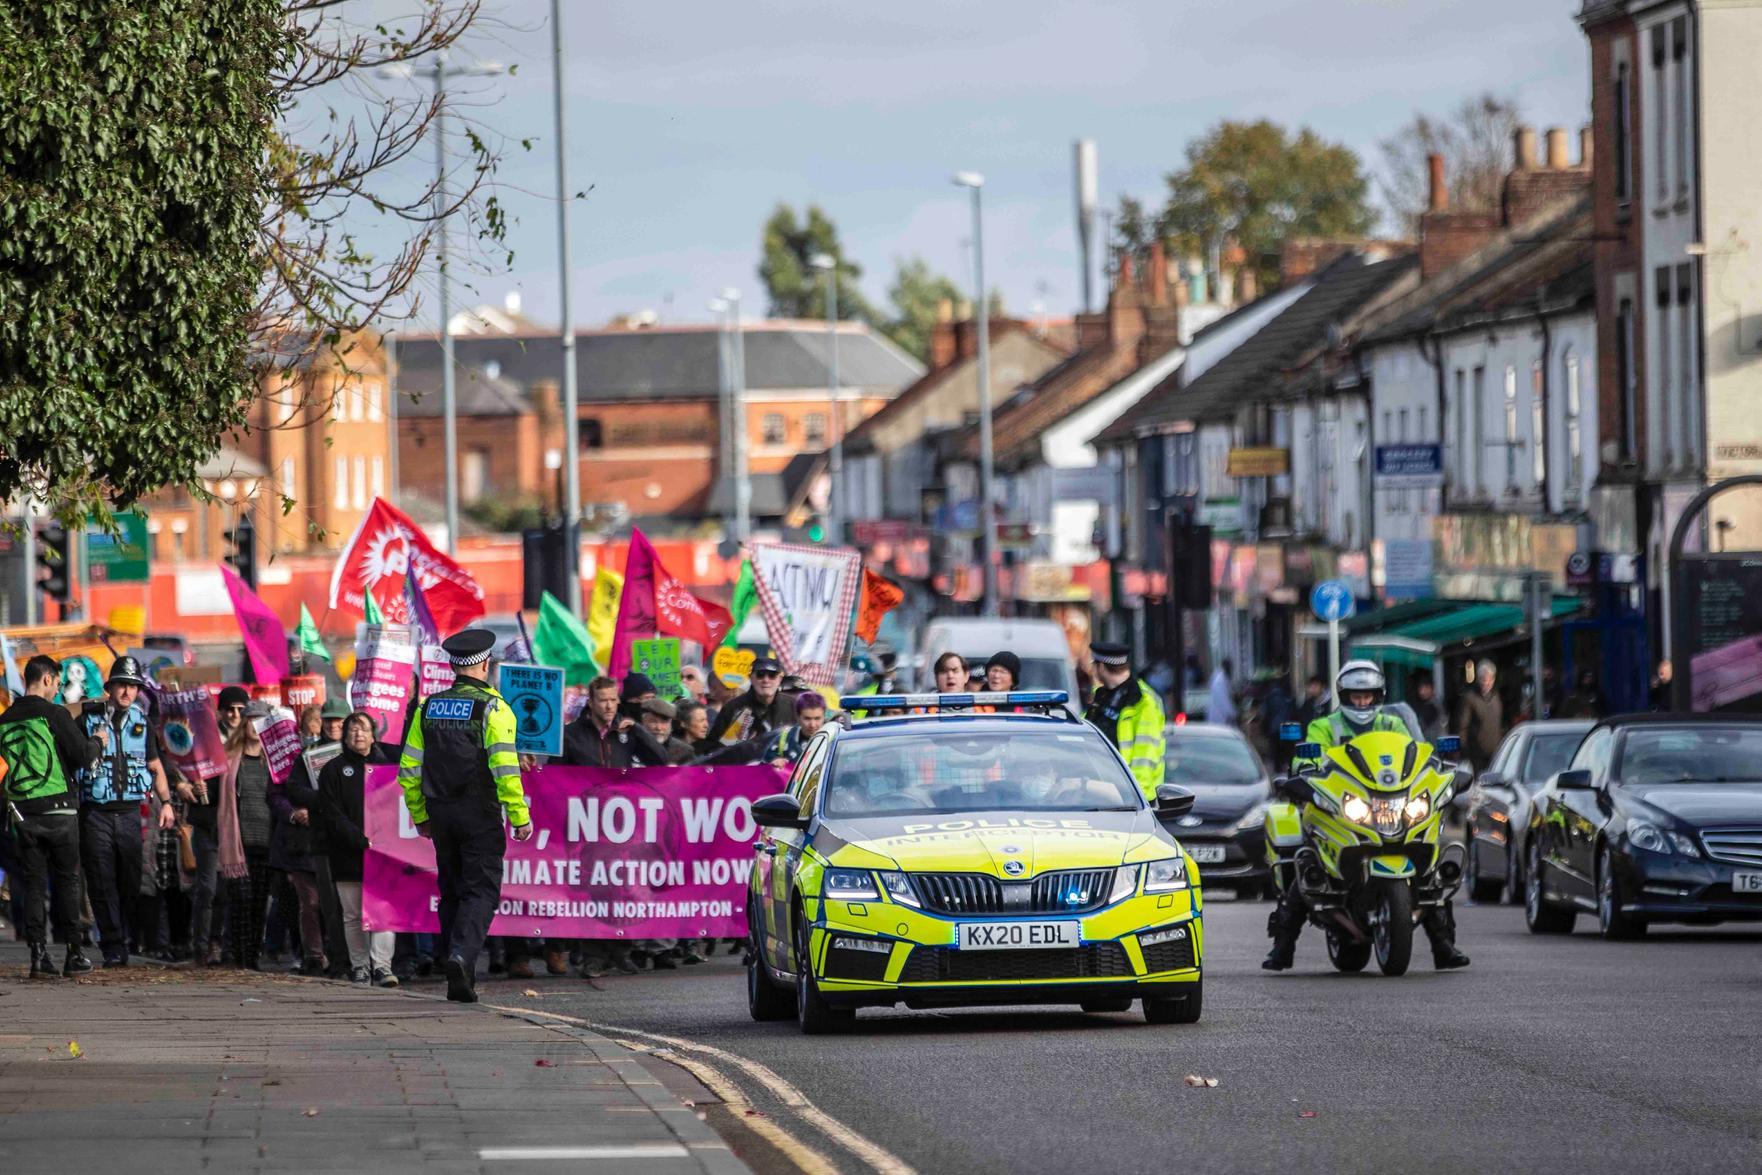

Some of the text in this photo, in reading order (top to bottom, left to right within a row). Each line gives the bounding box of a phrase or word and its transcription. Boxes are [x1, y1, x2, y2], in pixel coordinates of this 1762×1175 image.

[638, 643, 674, 657] LET
[423, 664, 457, 682] Clima
[506, 669, 558, 682] THERE IS NO
[511, 679, 553, 692] PLANET B
[287, 688, 316, 706] STOP
[428, 702, 470, 717] POLICE
[567, 796, 664, 844] NOT
[903, 818, 1093, 834] POLICE
[887, 829, 1120, 846] INTERCEPTOR
[503, 859, 581, 886] IMATE
[590, 860, 685, 887] ACTION
[528, 900, 608, 919] REBELLION
[613, 901, 732, 919] NORTHAMPTON
[967, 924, 1070, 946] KX20 EDL
